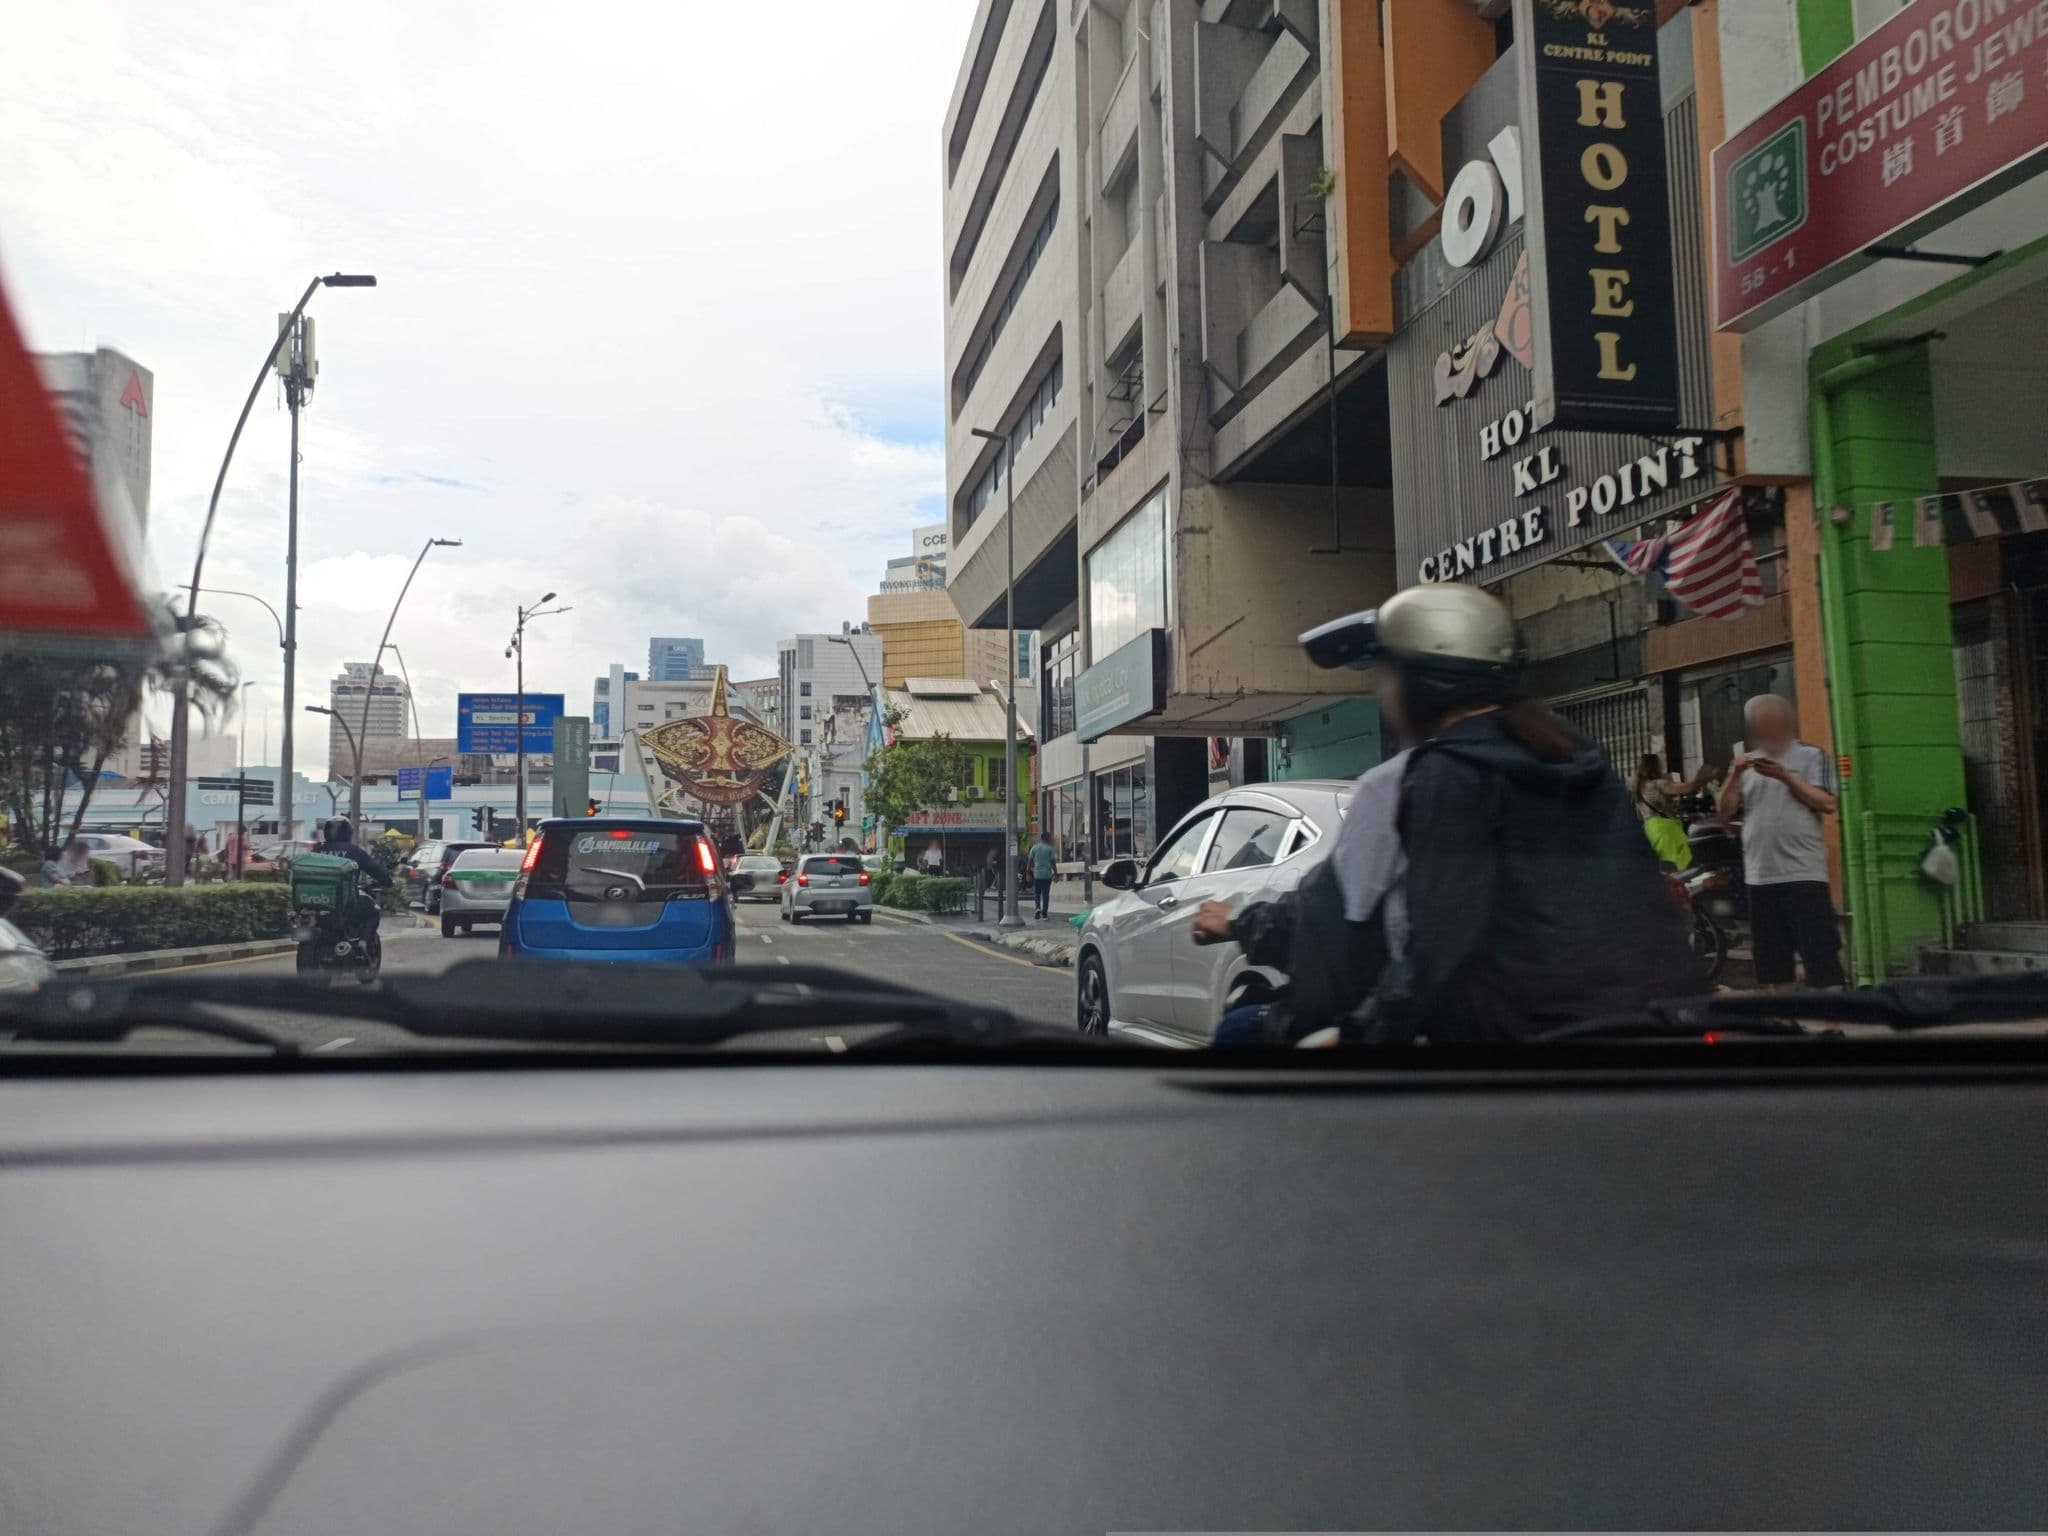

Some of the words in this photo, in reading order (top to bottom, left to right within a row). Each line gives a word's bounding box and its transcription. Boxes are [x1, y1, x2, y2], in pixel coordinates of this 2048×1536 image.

[1543, 44, 1603, 61] CENTRE
[1606, 51, 1653, 67] POINT
[1587, 32, 1608, 46] KL
[1820, 61, 1957, 176] COSTUME
[1576, 80, 1637, 381] HOTEL
[1741, 266, 1765, 296] 58
[1784, 248, 1796, 269] 1
[1512, 446, 1559, 497] KL
[1419, 507, 1545, 584] CENTRE
[1566, 437, 1703, 527] POINT
[300, 893, 330, 906] Grab
